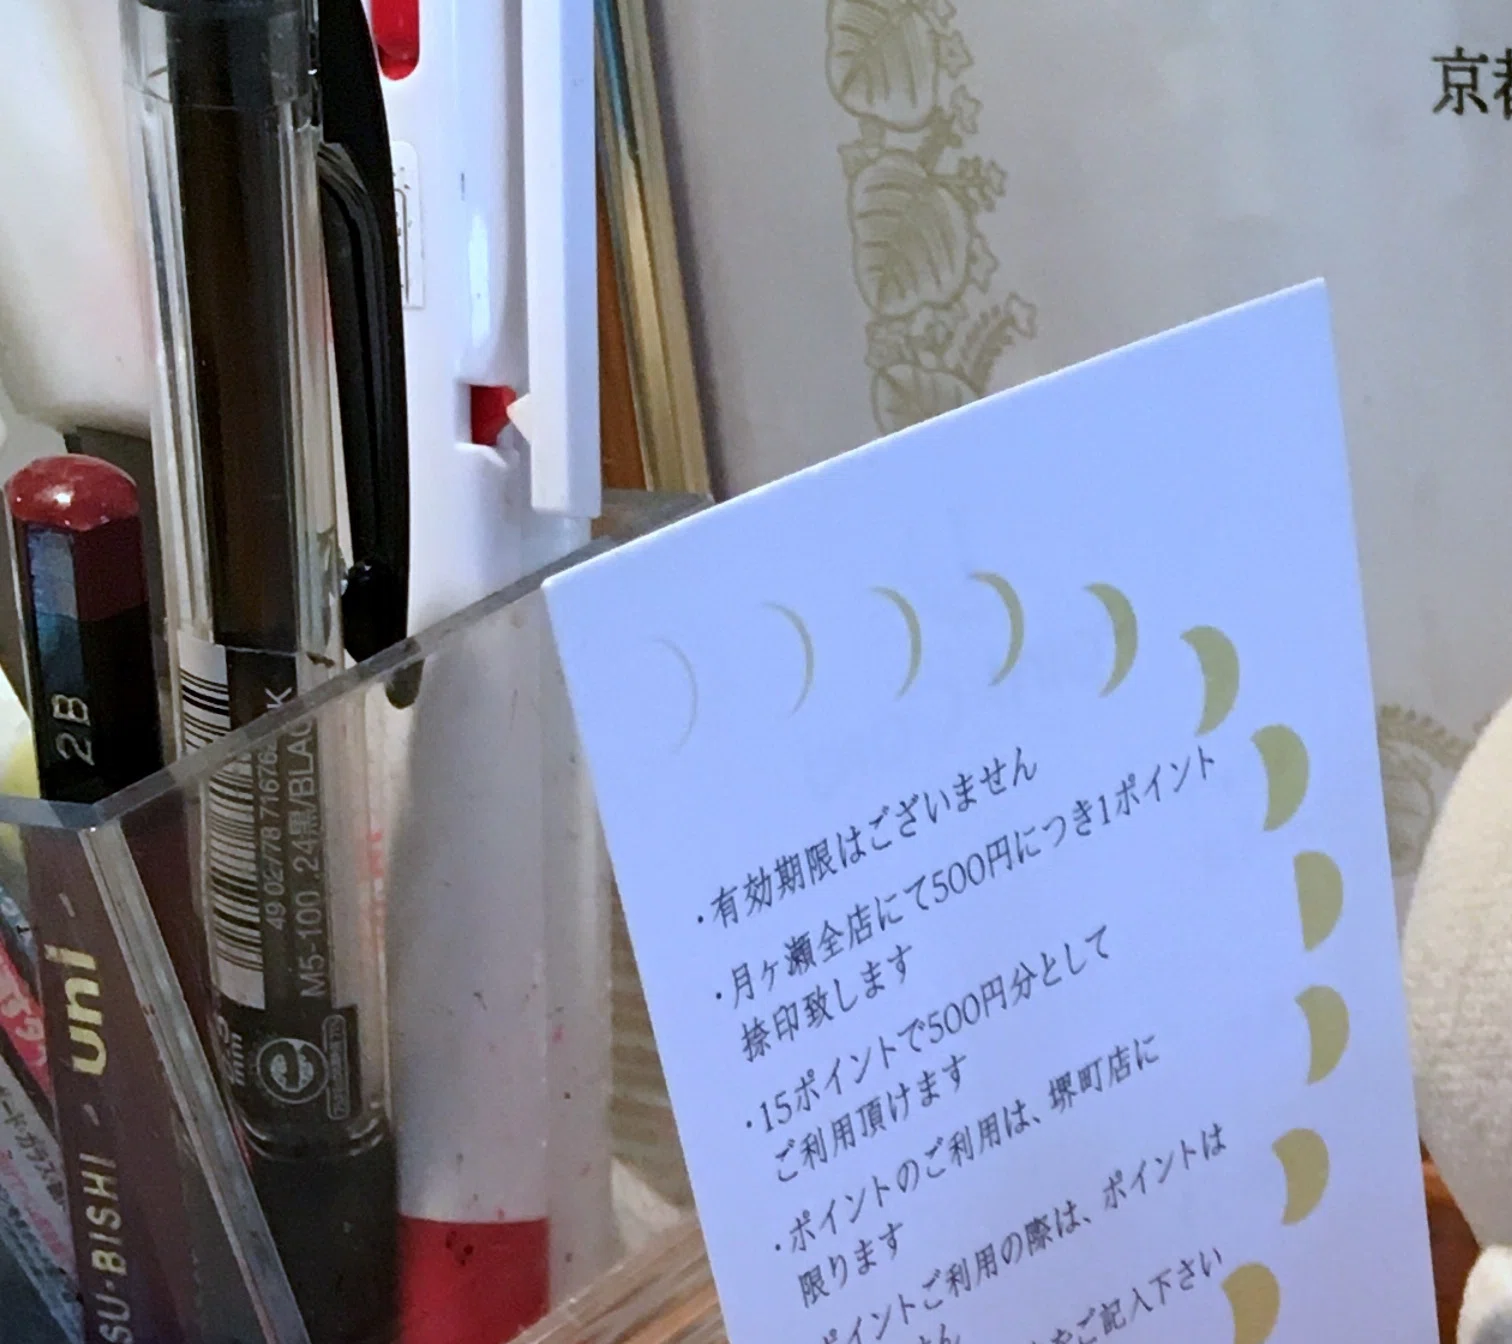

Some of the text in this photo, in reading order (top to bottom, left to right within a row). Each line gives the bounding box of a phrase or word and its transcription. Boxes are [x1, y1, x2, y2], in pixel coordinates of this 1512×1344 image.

[55, 693, 91, 766] 2B
[298, 890, 328, 999] M5-100
[45, 944, 107, 1077] uni
[740, 944, 912, 1062] 捺印致します
[774, 1054, 968, 1183] ご利用頂けます
[796, 1222, 904, 1308] 限ります
